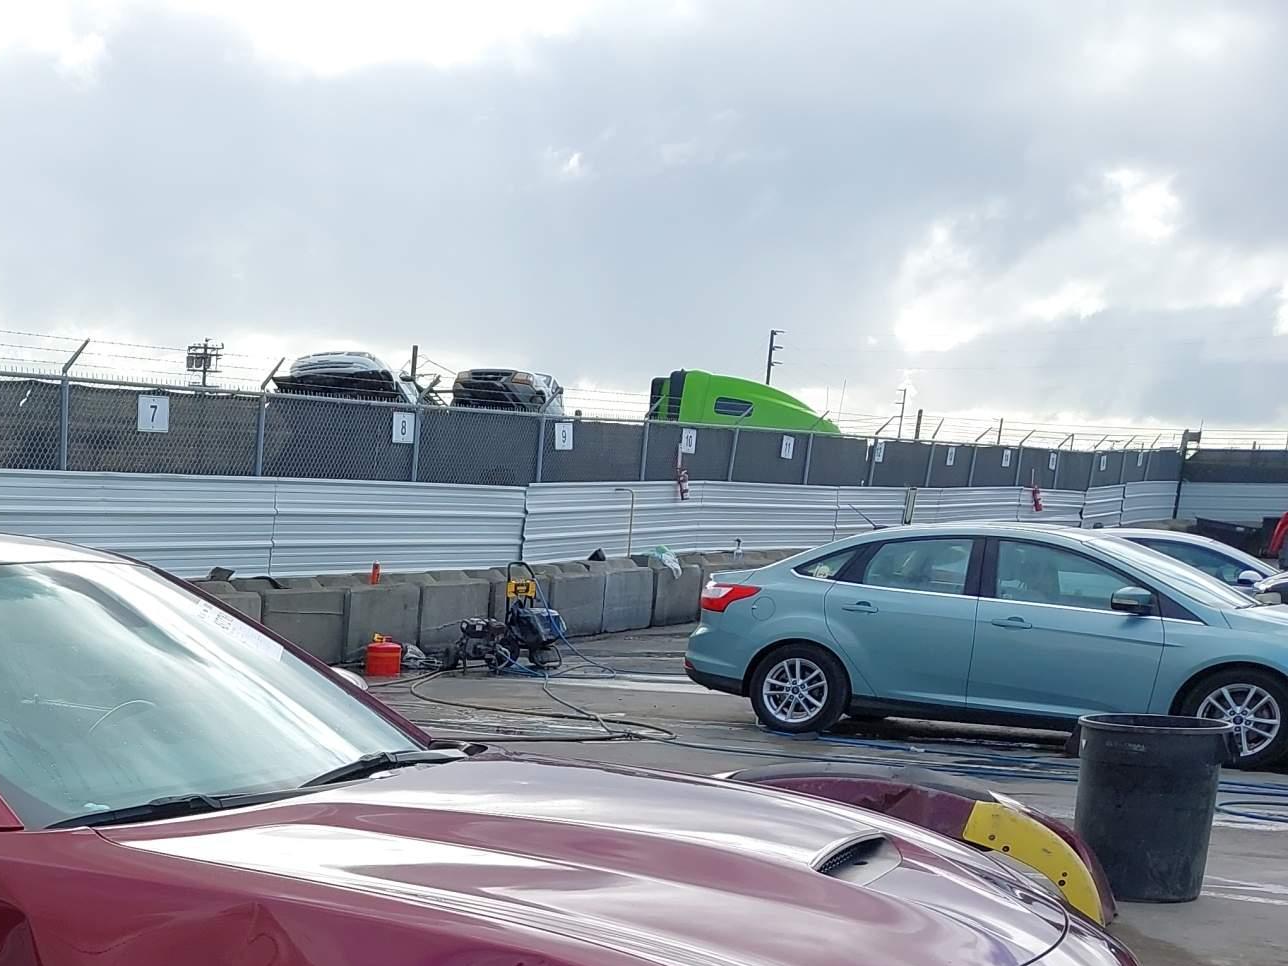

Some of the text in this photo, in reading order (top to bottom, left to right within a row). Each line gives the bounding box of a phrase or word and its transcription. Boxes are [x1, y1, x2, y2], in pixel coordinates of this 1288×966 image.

[149, 404, 158, 423] 7
[400, 420, 407, 436] 8
[561, 430, 567, 444] 9
[685, 434, 693, 448] 10
[784, 441, 791, 454] 11
